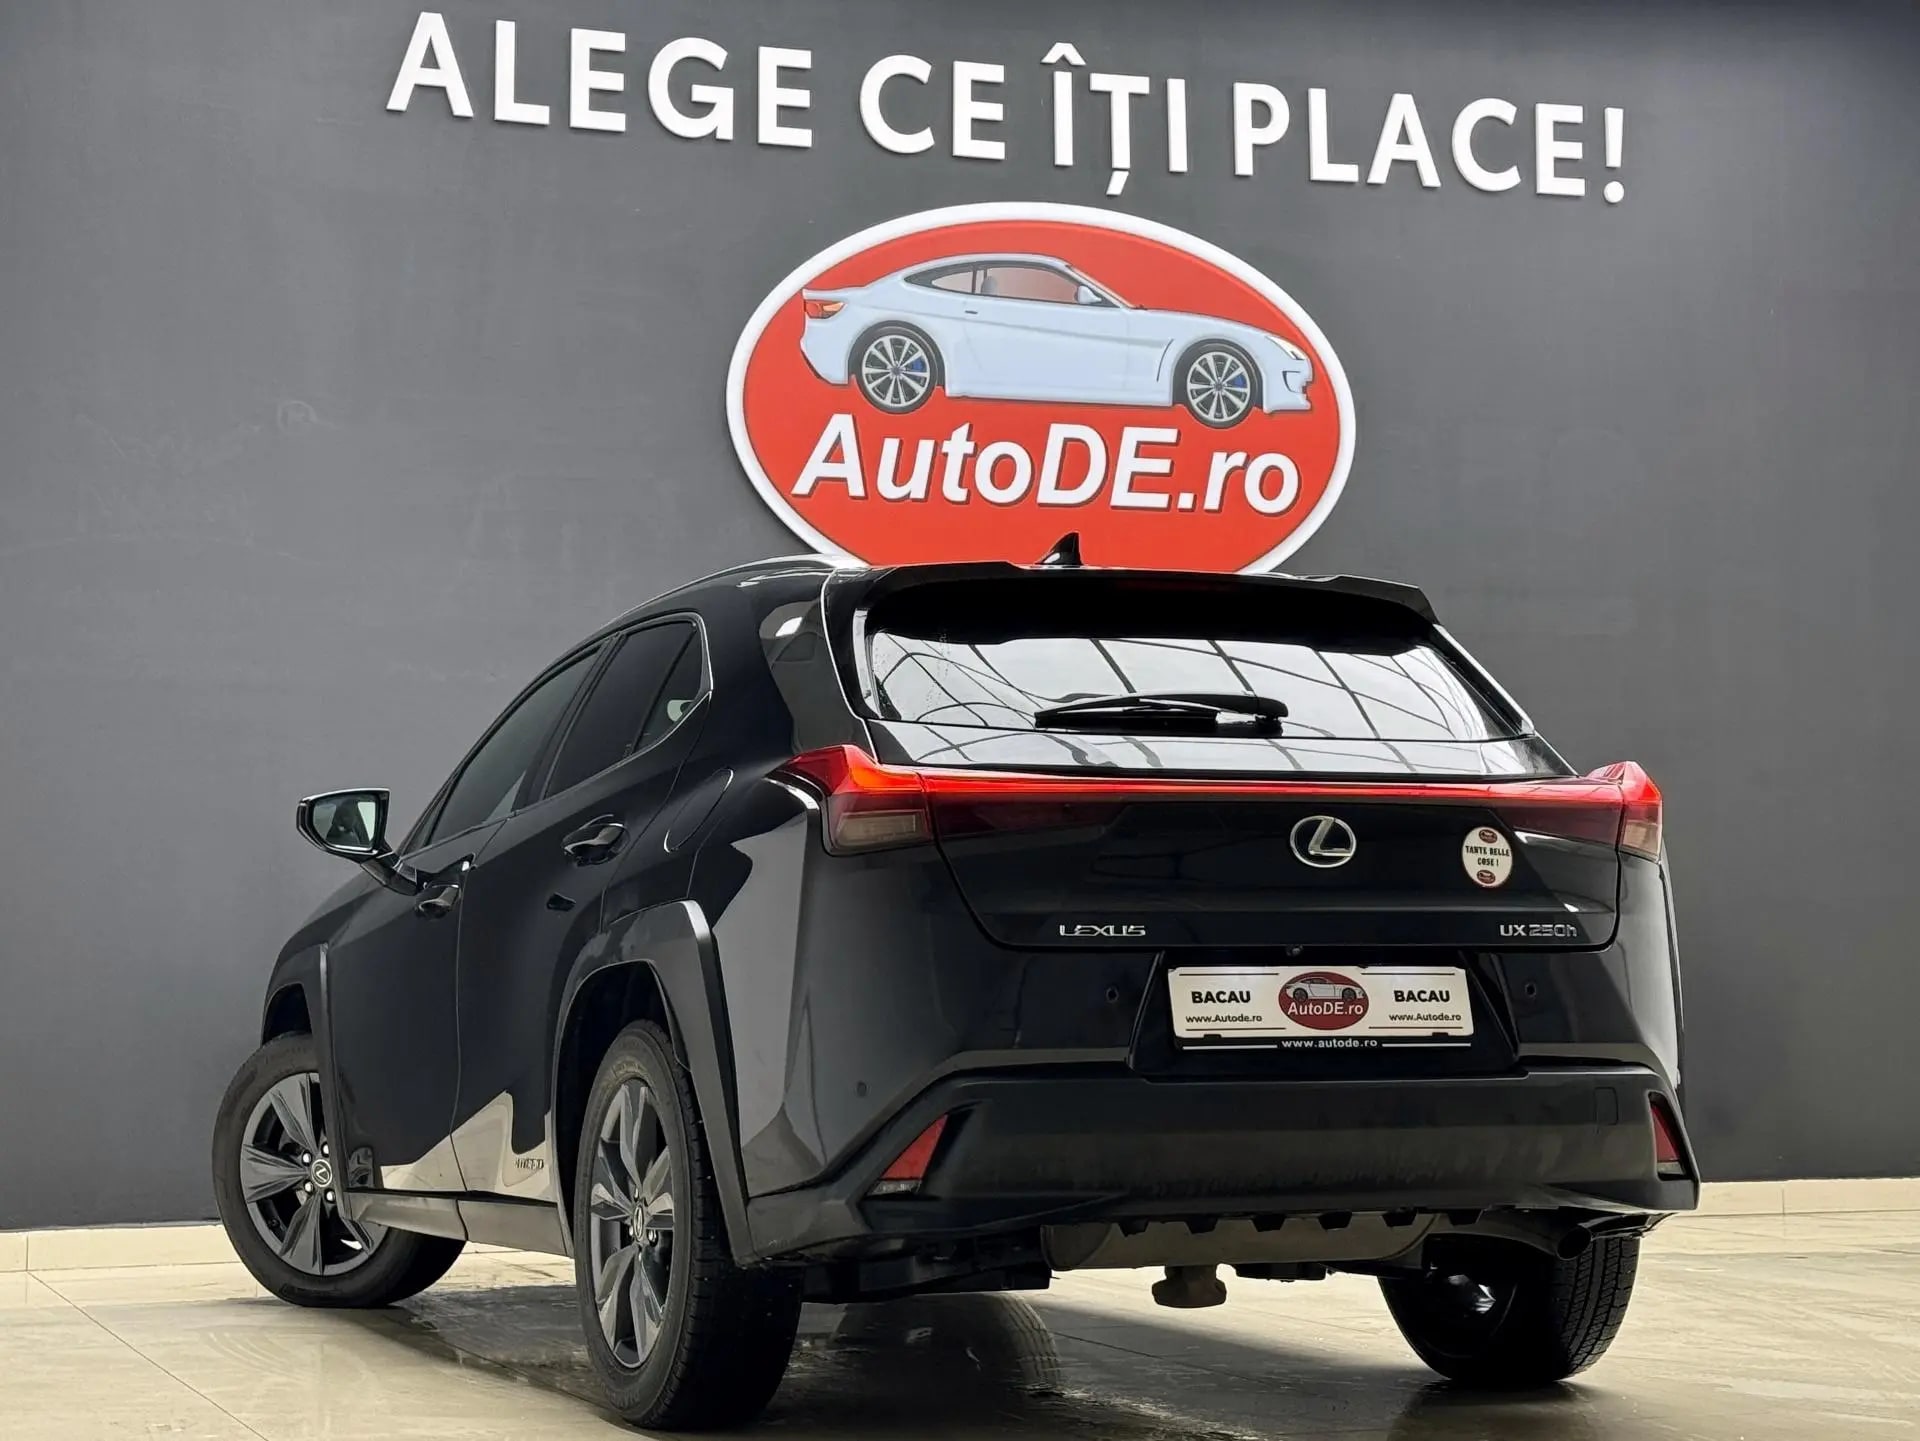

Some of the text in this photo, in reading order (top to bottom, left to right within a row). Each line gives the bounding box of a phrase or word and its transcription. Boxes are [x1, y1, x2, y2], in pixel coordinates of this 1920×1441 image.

[386, 11, 812, 148] ALEGE
[859, 54, 1006, 160] CE
[1233, 82, 1625, 204] PLACE!
[791, 412, 1301, 515] AutoDE.ro
[1465, 845, 1510, 857] TANTE BELLE
[1477, 857, 1494, 867] COSE
[1059, 924, 1146, 937] LEXUS
[1500, 924, 1578, 937] UX 250h
[1191, 990, 1251, 1004] BACAU
[1393, 990, 1450, 1002] BACAU
[1287, 1002, 1364, 1015] AutoDE.ro
[1185, 1014, 1262, 1023] www.Autode.ro
[1389, 1013, 1462, 1021] www.Autode.ro
[1281, 1038, 1378, 1048] www.autode.ro
